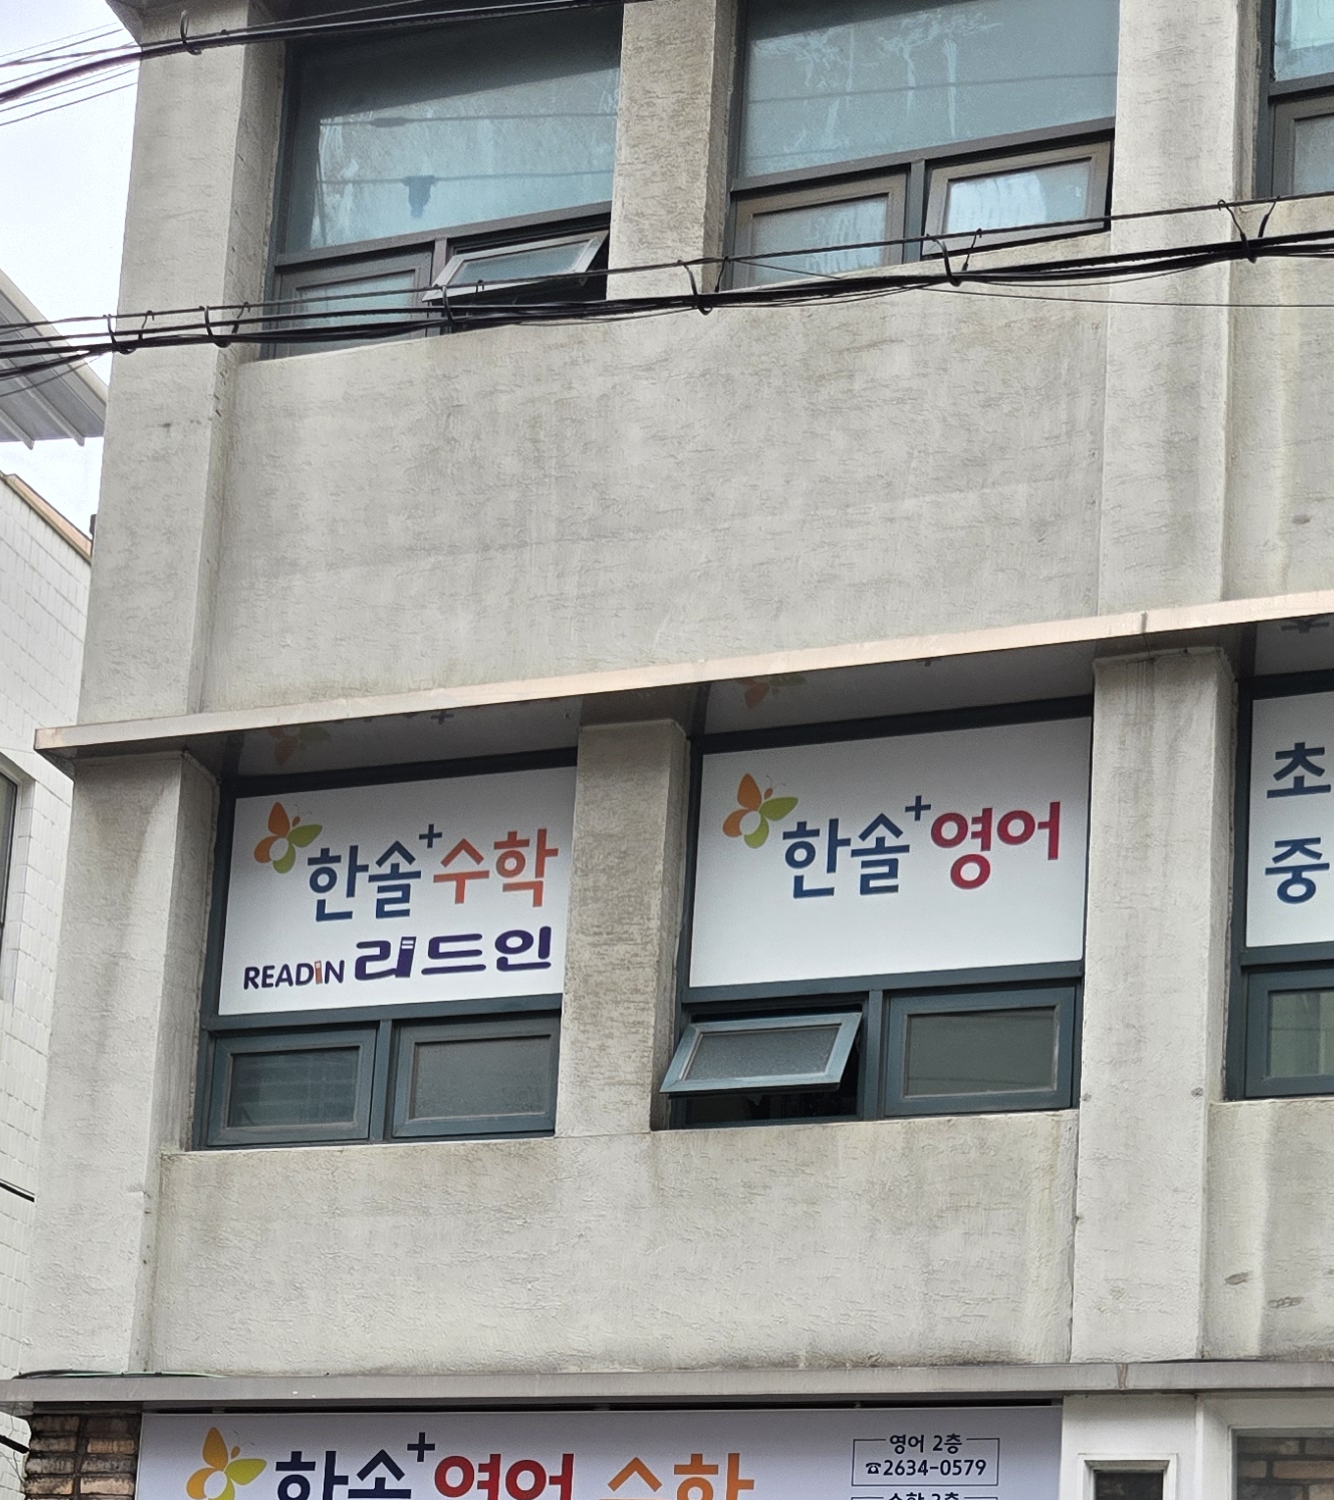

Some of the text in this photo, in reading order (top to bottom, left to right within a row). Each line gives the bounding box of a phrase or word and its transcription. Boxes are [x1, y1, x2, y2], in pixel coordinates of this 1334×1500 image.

[354, 926, 553, 978] 리드인
[890, 1434, 962, 1454] 영어 2층
[883, 1460, 986, 1476] 2634-0579
